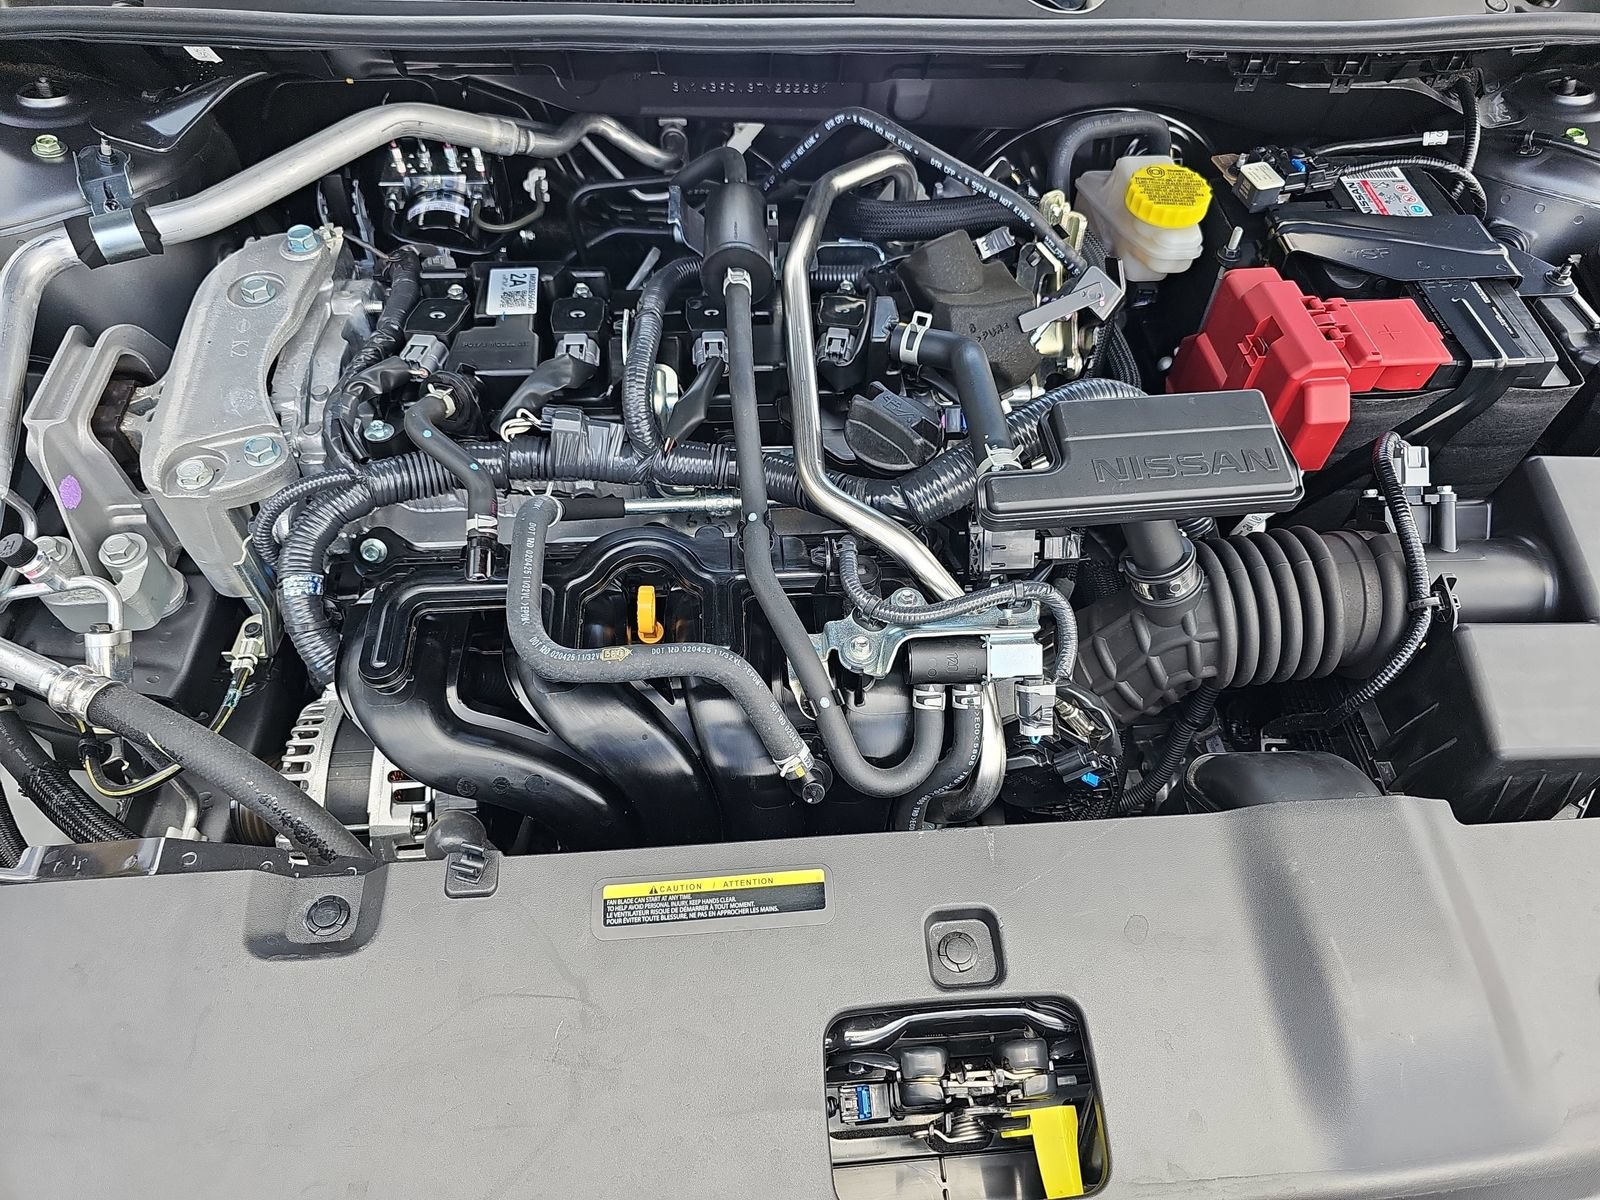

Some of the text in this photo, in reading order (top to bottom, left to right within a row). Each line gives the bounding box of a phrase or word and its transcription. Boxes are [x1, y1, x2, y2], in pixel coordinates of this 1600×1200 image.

[1000, 195, 1012, 208] NOT
[1014, 206, 1030, 224] KINK
[1091, 447, 1280, 483] NISSAN
[660, 883, 702, 893] CAUTION
[723, 878, 774, 888] ATTENTION
[614, 910, 650, 918] VENTILATEUR
[680, 904, 708, 913] DÉMARRER
[644, 902, 670, 910] PERSONAL
[623, 916, 641, 924] ÉVITER
[717, 908, 750, 916] APPROCHER
